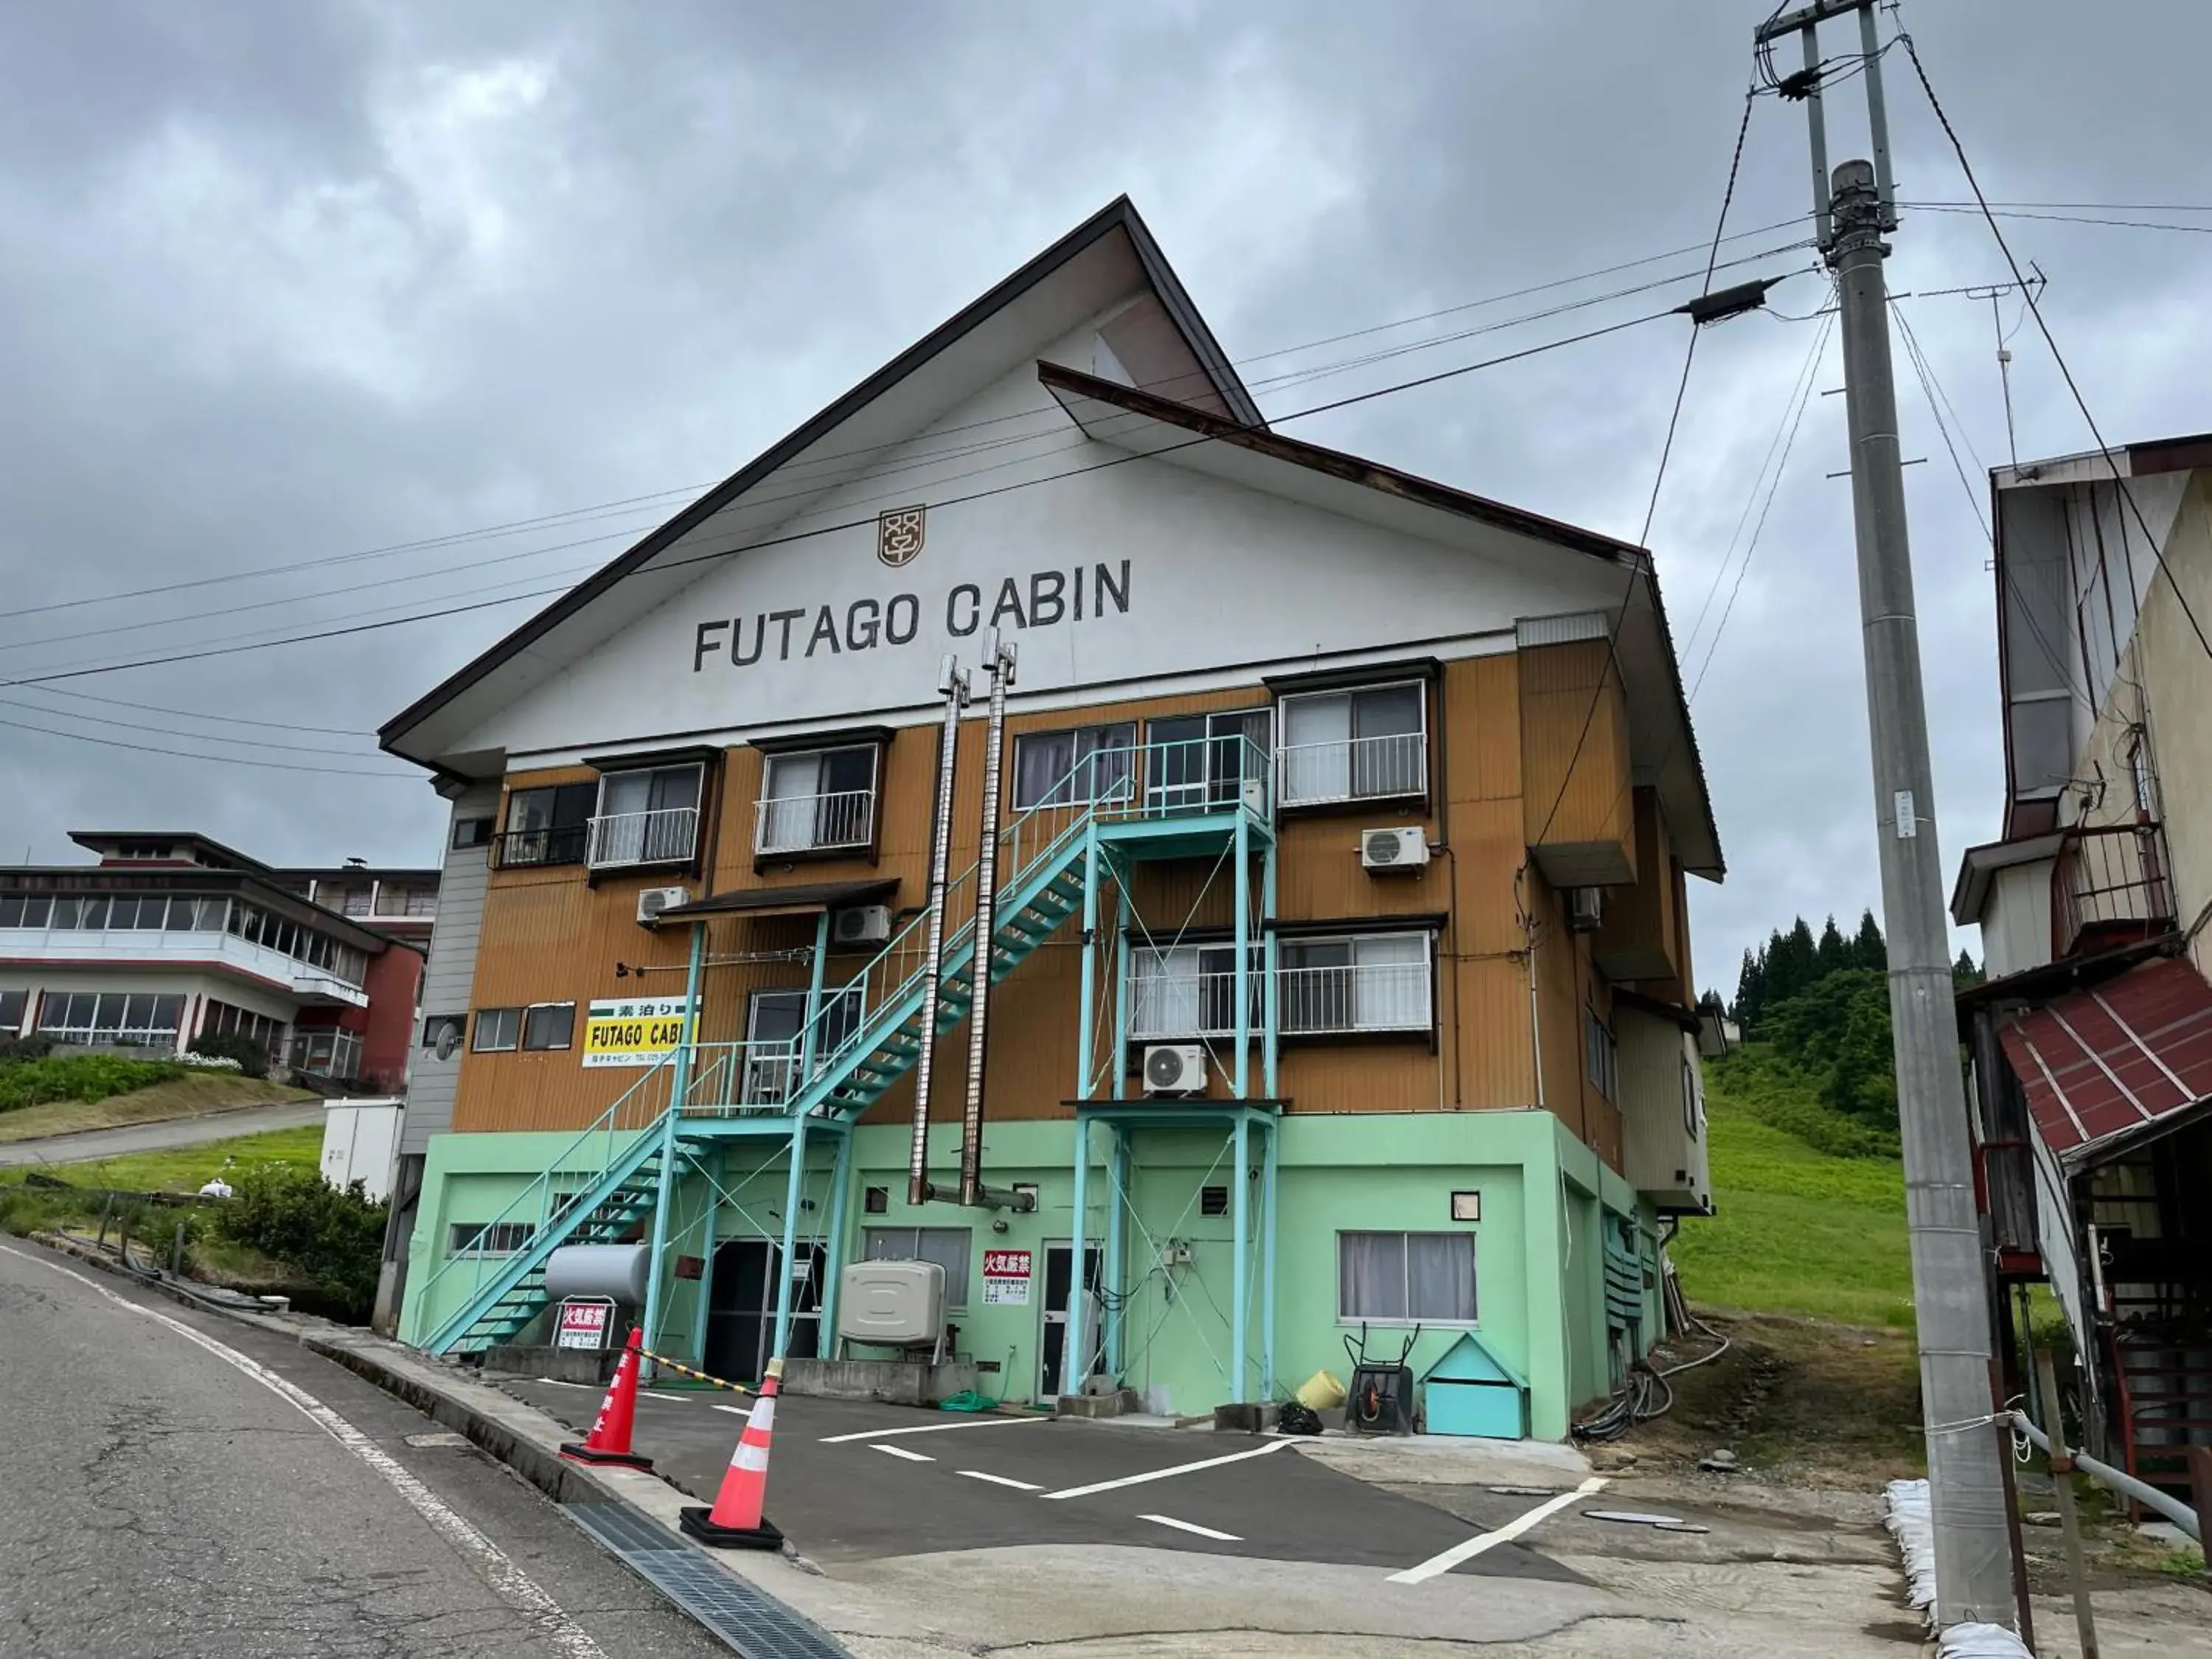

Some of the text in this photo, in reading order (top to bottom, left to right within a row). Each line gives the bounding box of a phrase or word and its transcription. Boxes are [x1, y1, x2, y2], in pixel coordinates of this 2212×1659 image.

[694, 559, 1131, 672] FUTAGO CABIN
[618, 1004, 672, 1018] 素泊り
[591, 1023, 684, 1048] FUTAGO CABI
[984, 1254, 1030, 1273] 火気厳禁
